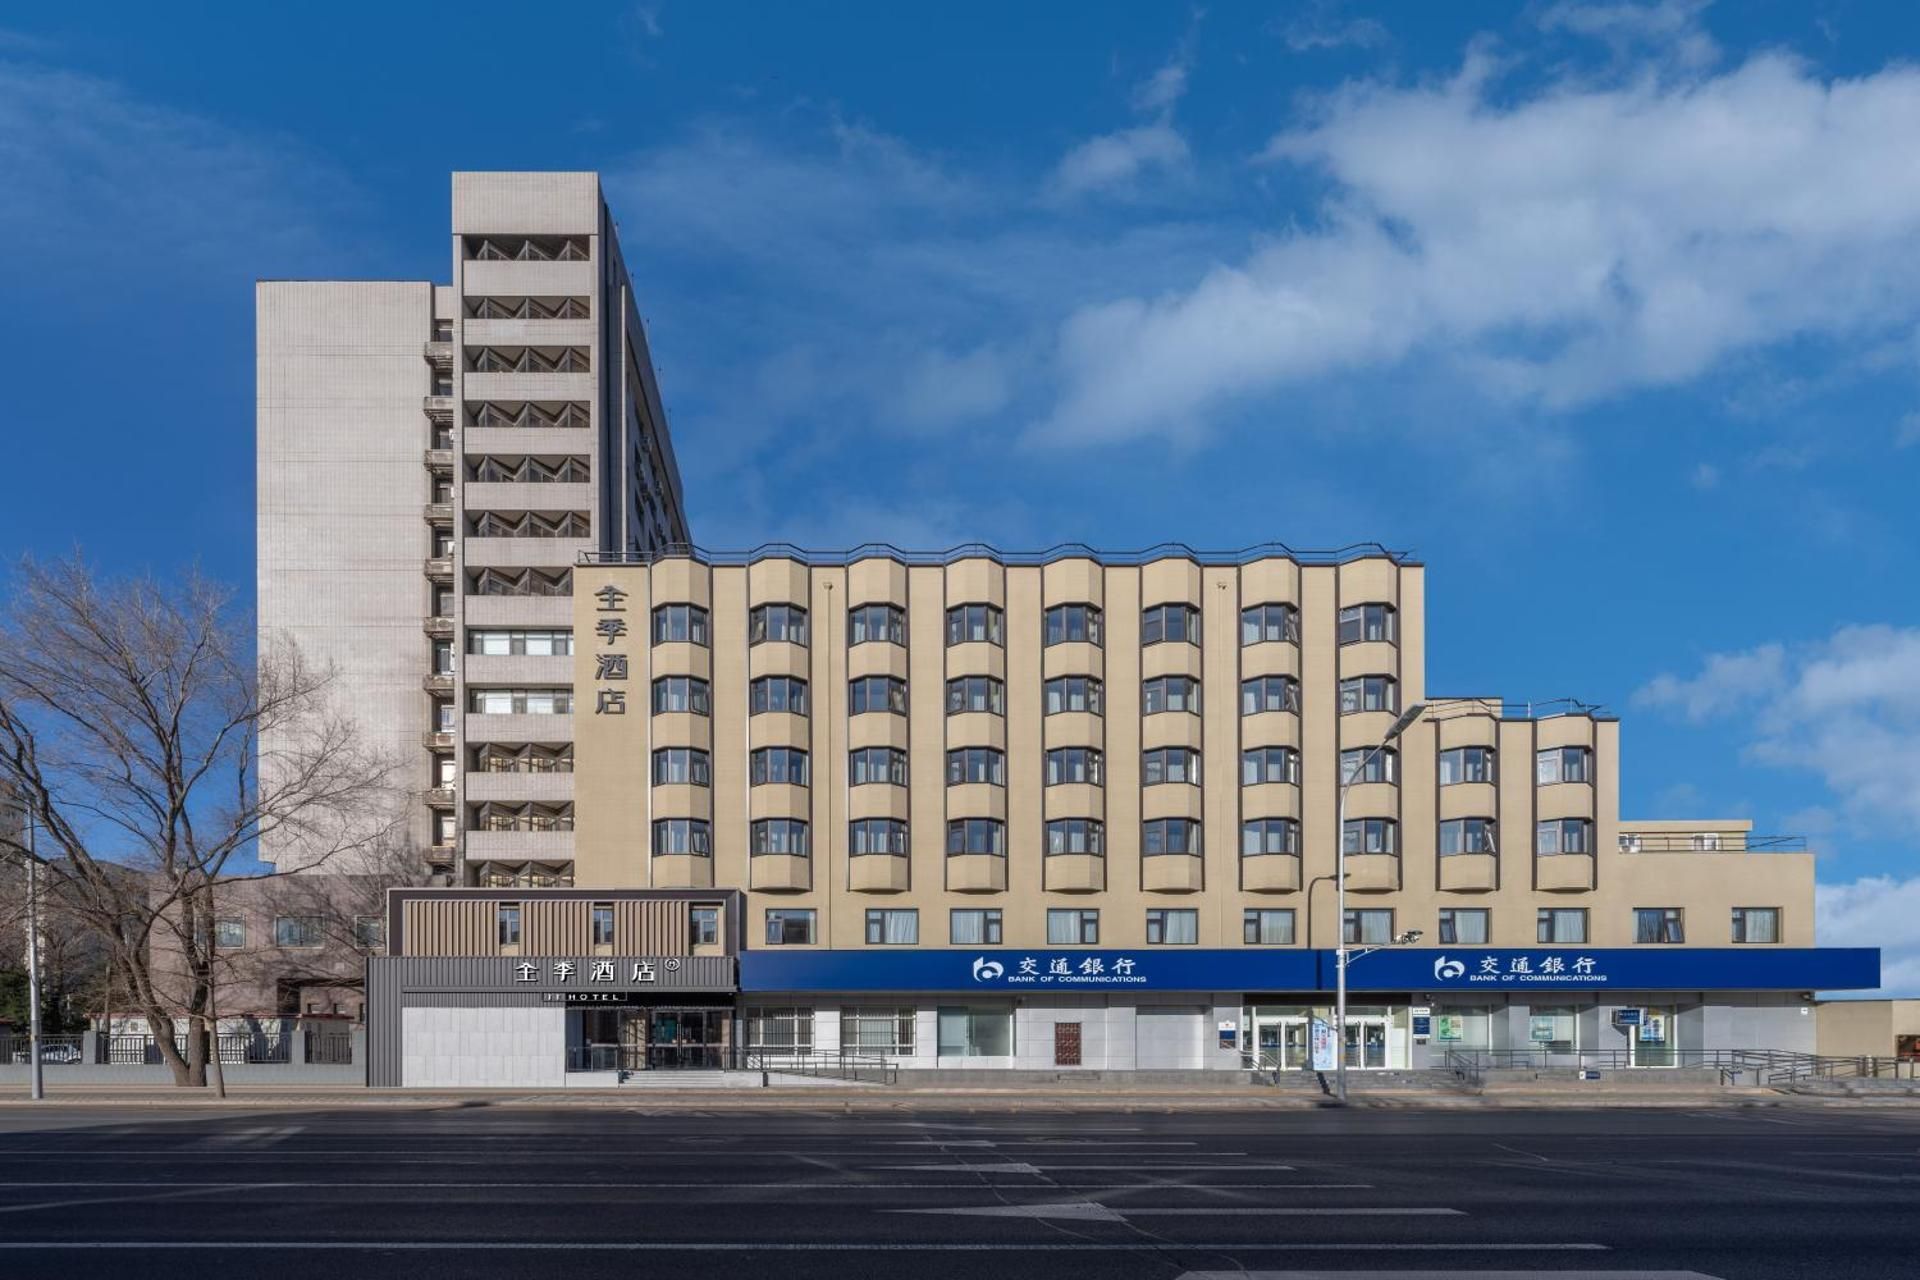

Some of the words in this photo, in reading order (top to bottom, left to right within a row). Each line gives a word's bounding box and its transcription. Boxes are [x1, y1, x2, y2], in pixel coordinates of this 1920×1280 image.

[594, 585, 629, 715] 全季酒店
[515, 960, 656, 982] 全季酒店
[568, 993, 619, 1001] HOTEL
